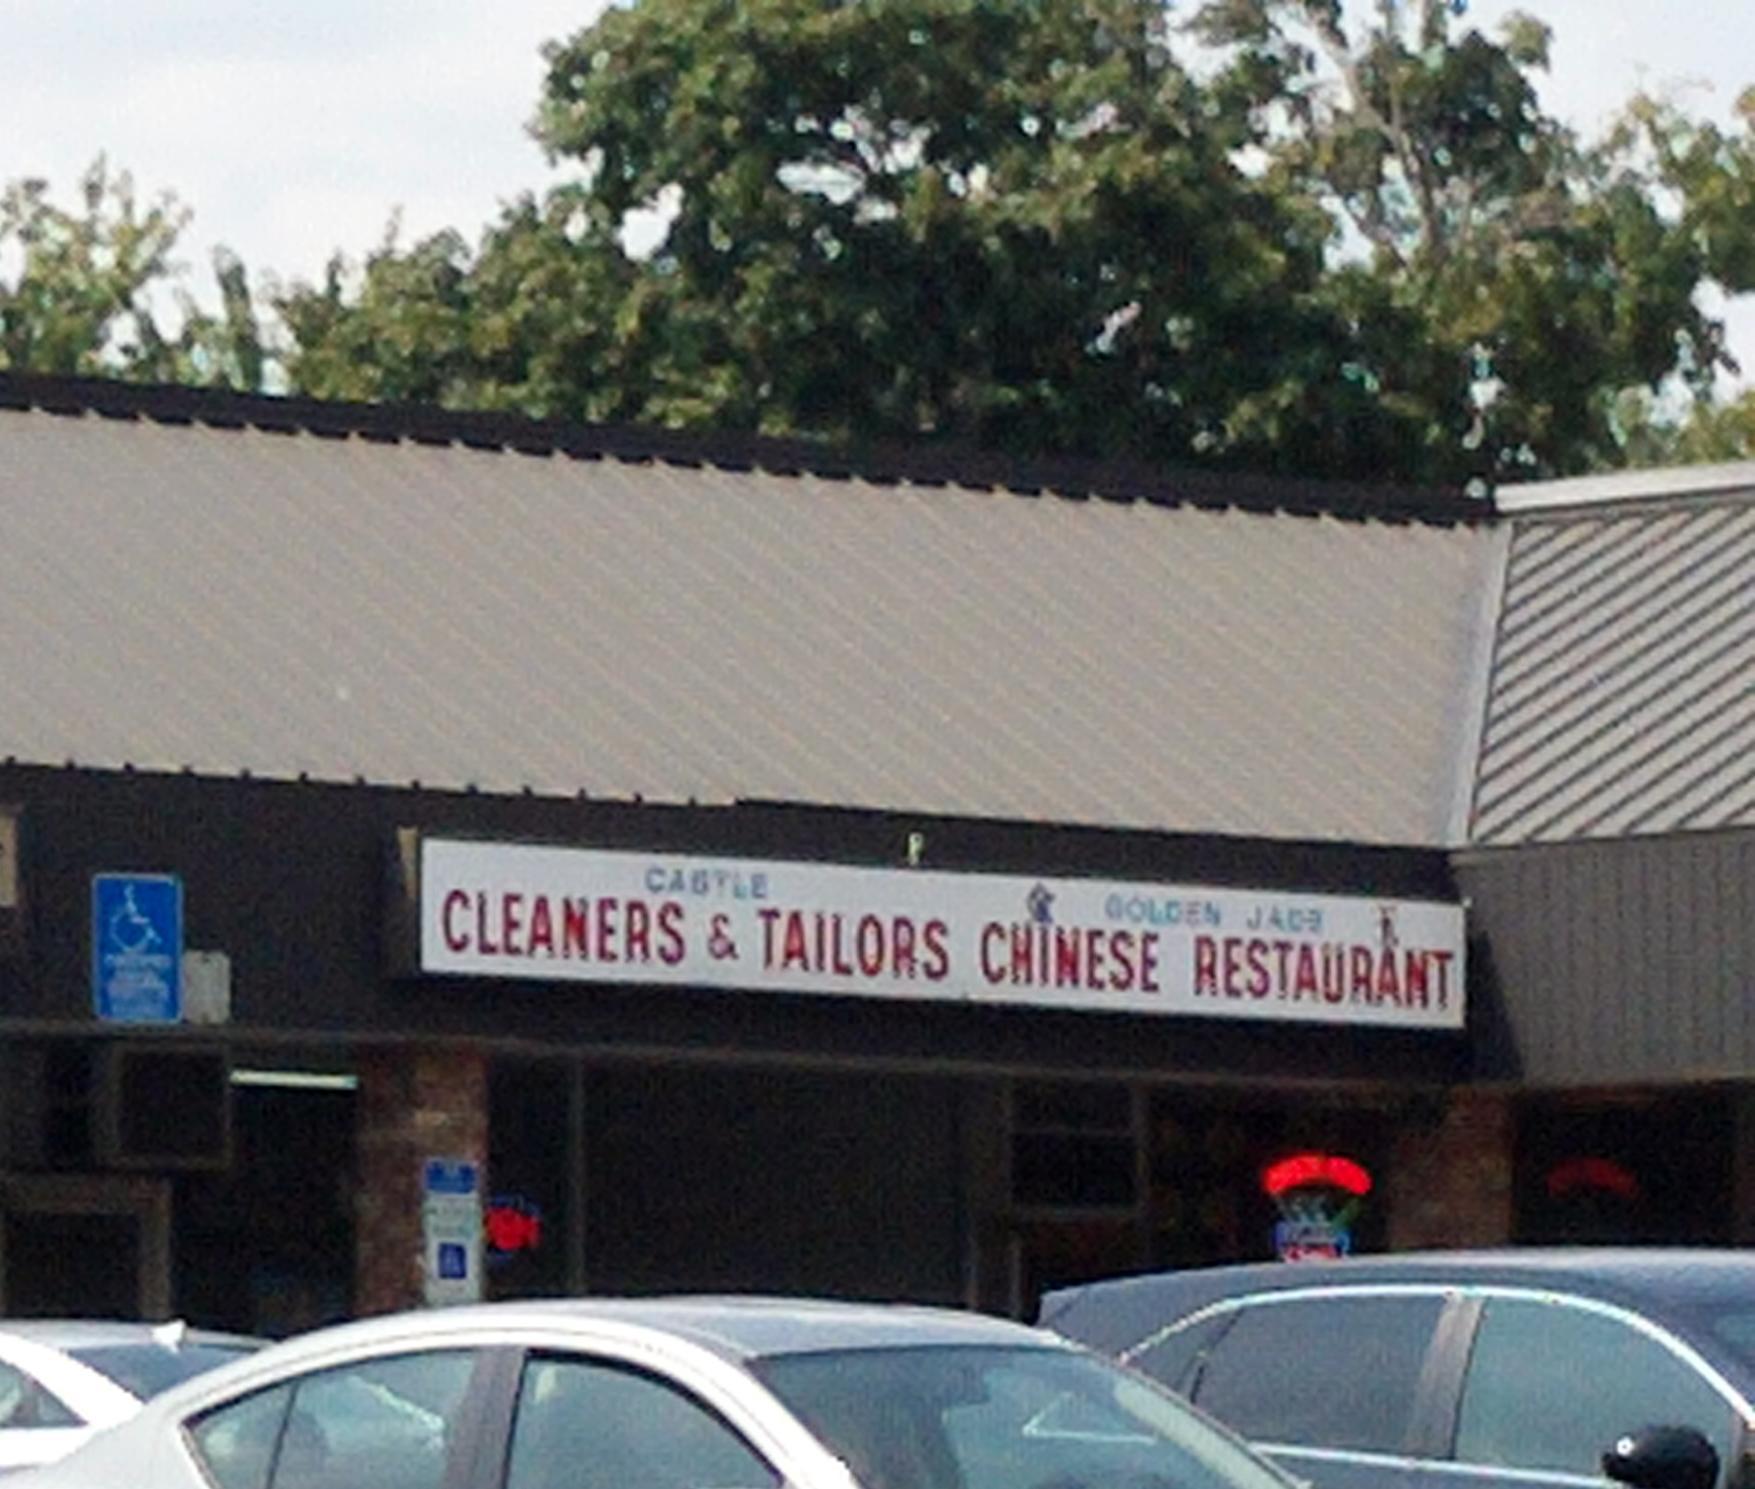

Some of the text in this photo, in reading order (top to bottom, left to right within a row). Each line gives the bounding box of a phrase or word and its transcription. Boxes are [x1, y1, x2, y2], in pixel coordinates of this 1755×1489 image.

[645, 867, 768, 899] CASTLE
[1104, 892, 1221, 929] GOLDEN
[441, 888, 1455, 1011] CLEANERS & TAILORS CHINESE RESTAURANT
